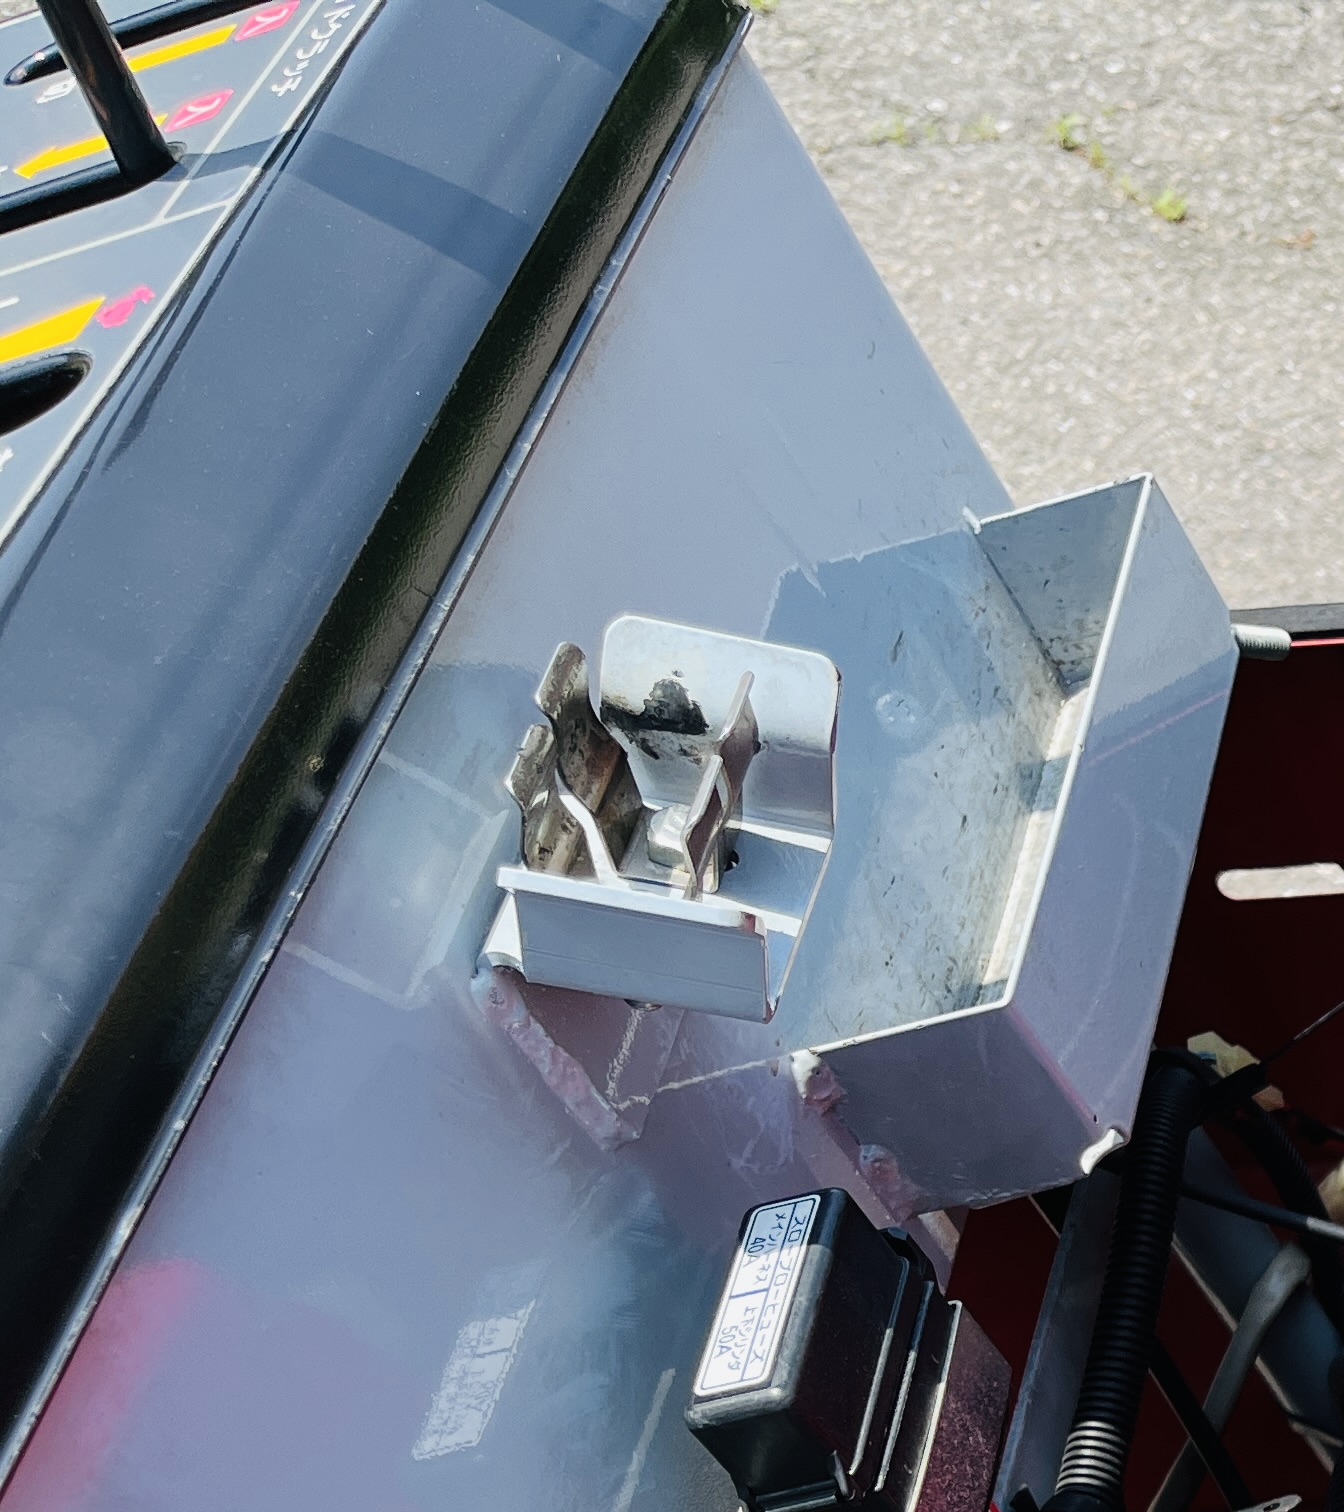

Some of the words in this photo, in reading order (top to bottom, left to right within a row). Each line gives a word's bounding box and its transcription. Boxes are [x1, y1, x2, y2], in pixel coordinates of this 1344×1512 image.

[271, 0, 356, 97] ドクラッチ
[743, 1236, 766, 1268] 40A
[755, 1212, 787, 1285] メインハーネス
[713, 1325, 739, 1360] 50A
